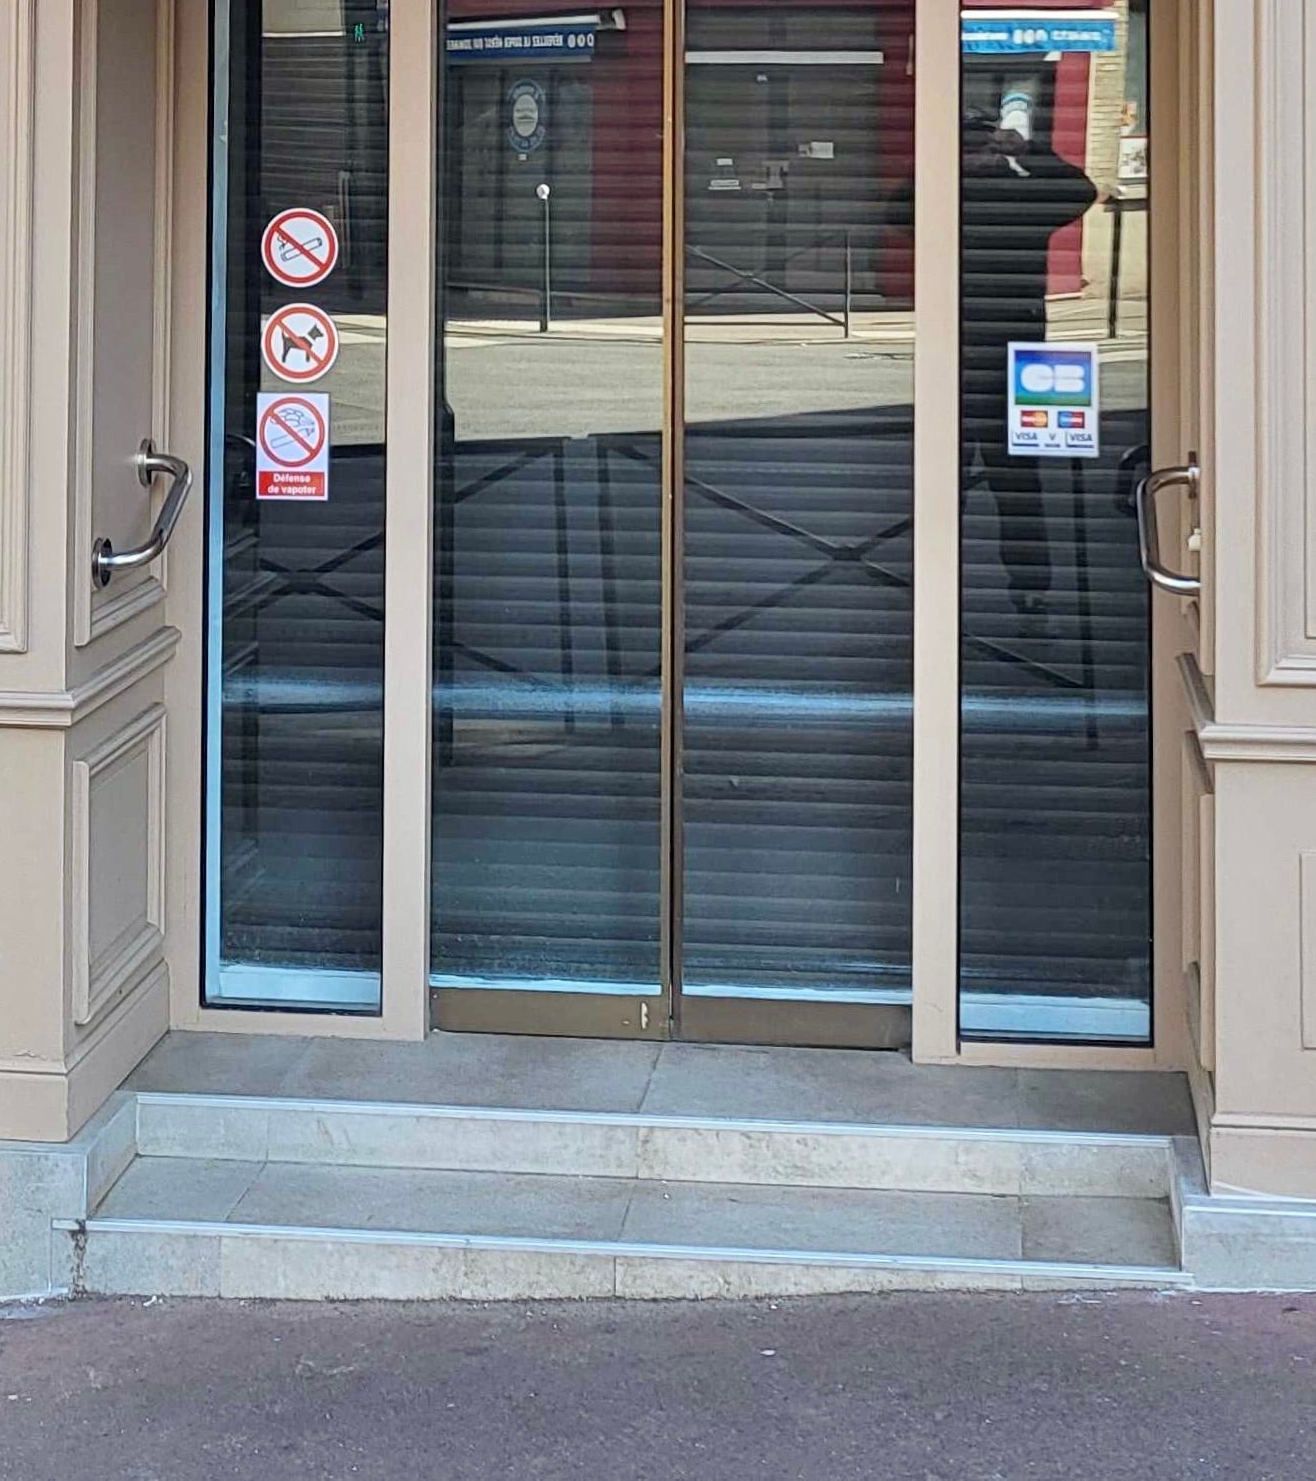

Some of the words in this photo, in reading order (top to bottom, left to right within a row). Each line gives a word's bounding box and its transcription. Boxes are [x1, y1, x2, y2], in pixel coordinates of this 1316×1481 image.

[273, 473, 311, 483] Défense
[267, 484, 279, 494] de
[281, 485, 317, 496] vapoter
